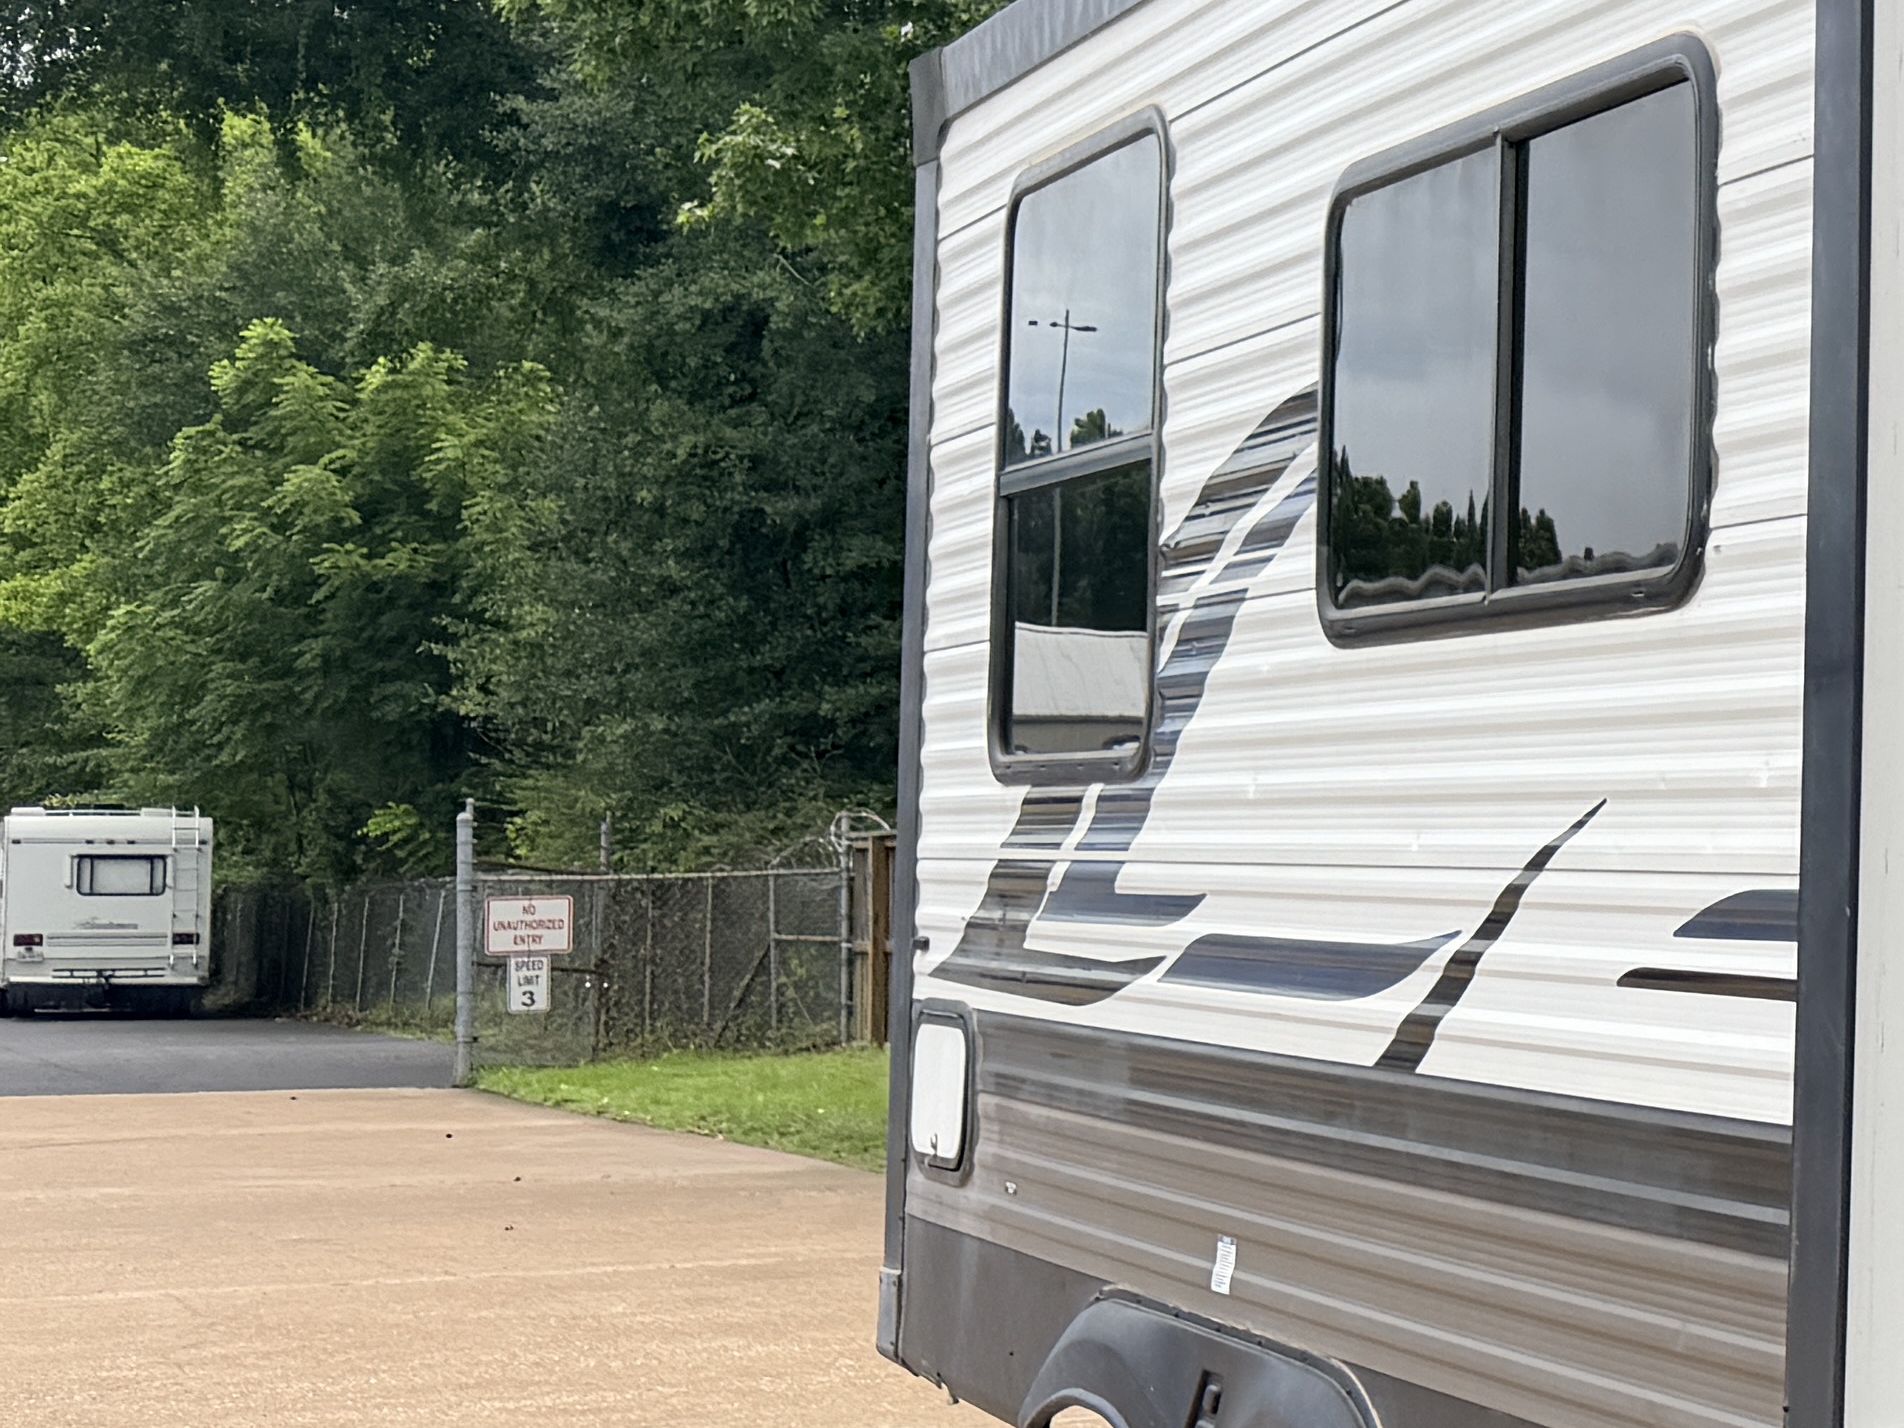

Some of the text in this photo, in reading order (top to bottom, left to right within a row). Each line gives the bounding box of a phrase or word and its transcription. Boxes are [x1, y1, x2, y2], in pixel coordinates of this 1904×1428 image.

[522, 903, 536, 916] NO
[493, 918, 565, 932] UNAUTHORIZED
[513, 934, 544, 946] ENTRY
[515, 959, 544, 972] SPEED
[517, 975, 540, 987] LIMIT
[521, 990, 536, 1007] 3
